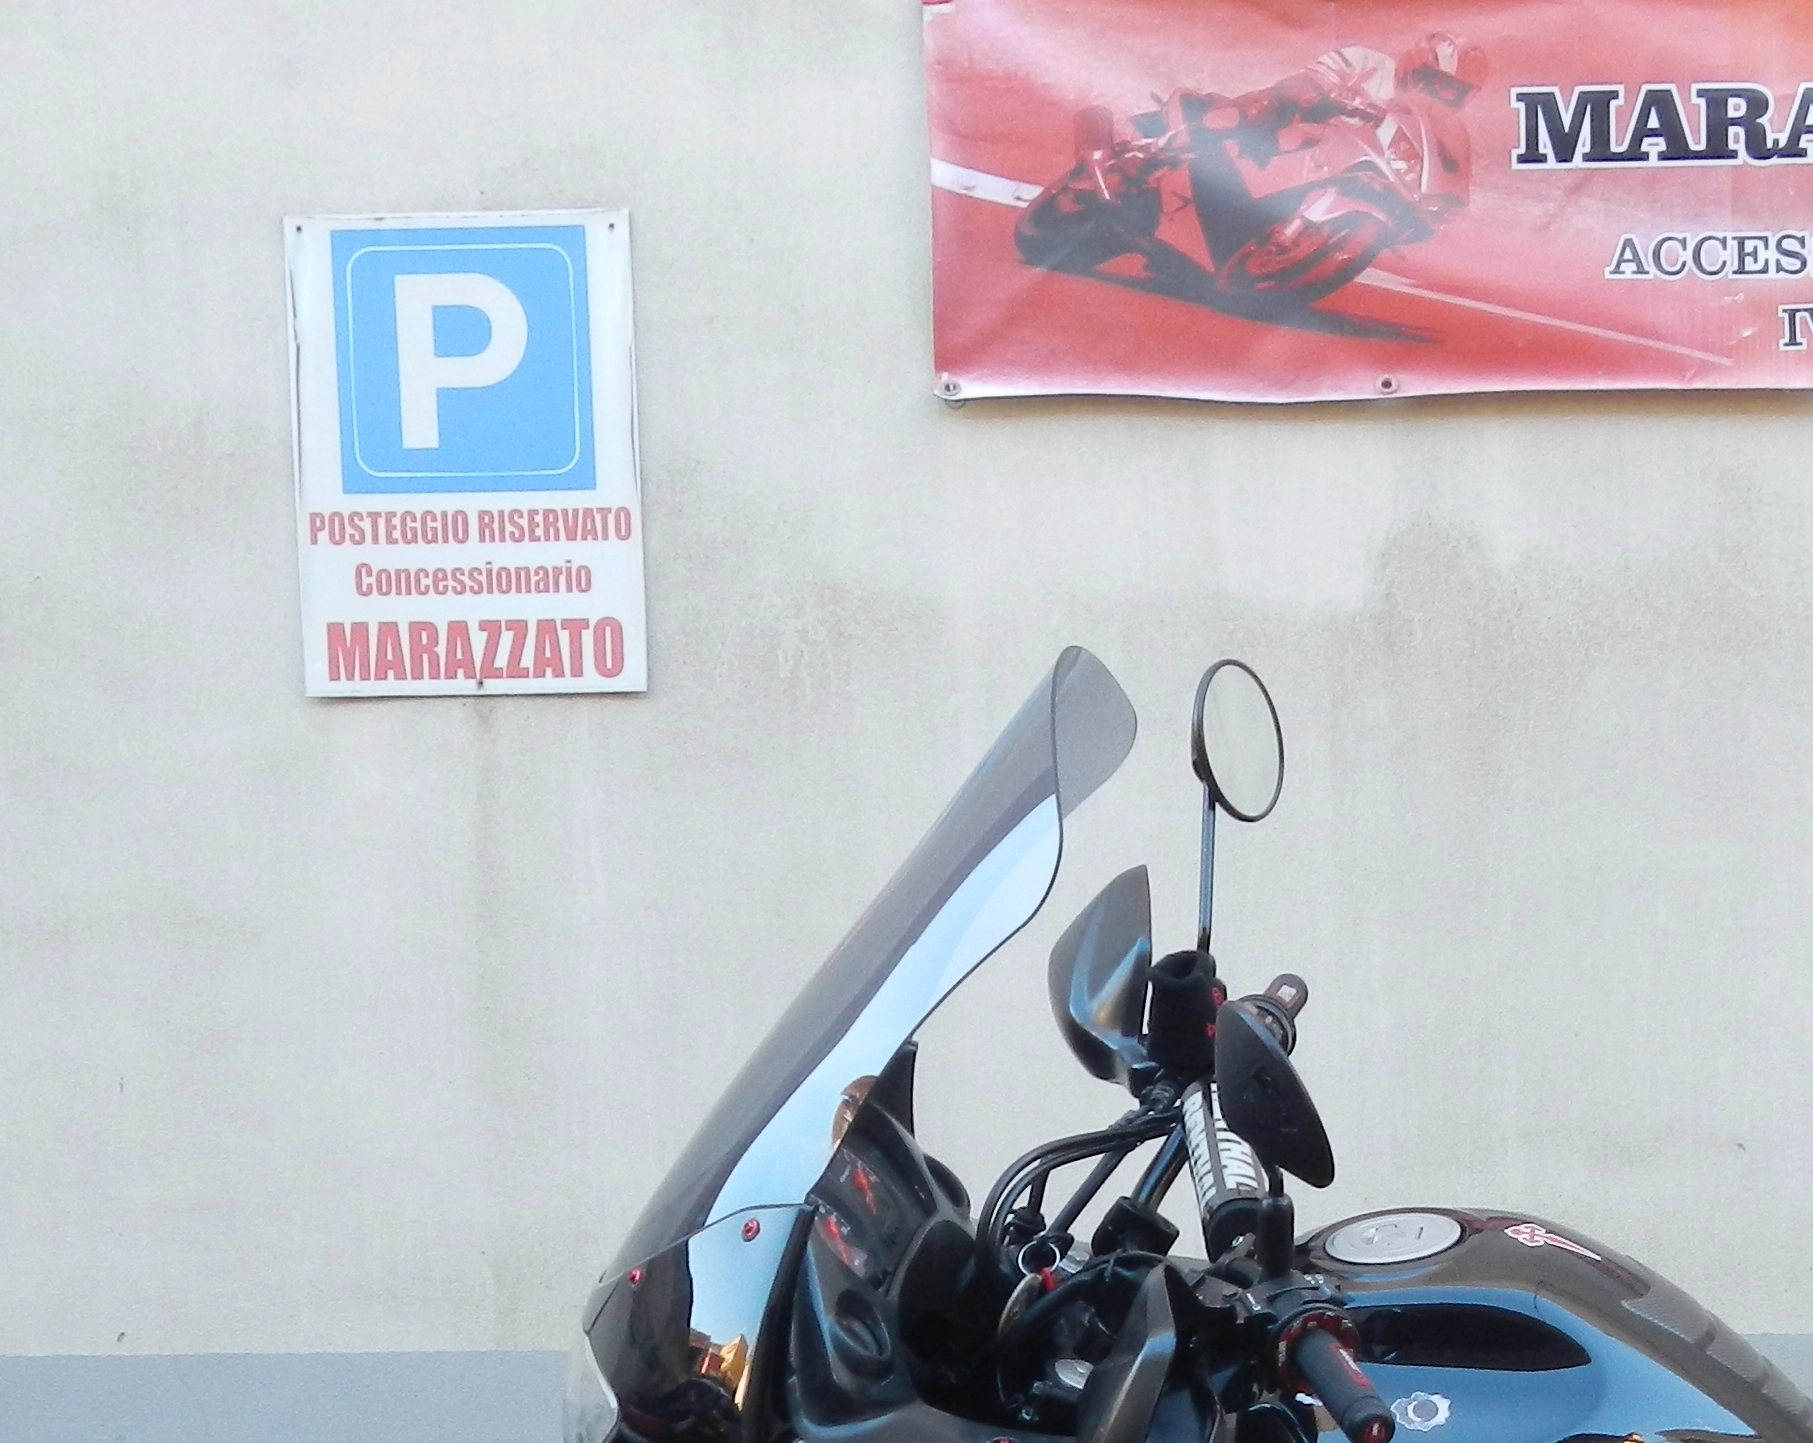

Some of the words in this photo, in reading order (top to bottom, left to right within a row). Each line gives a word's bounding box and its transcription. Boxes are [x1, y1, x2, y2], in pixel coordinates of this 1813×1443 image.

[394, 272, 528, 449] P
[310, 511, 469, 546] POSTEGGIO
[478, 507, 632, 543] RISERVATO
[354, 560, 592, 596] Concessionario
[326, 617, 625, 682] MARAZZATO
